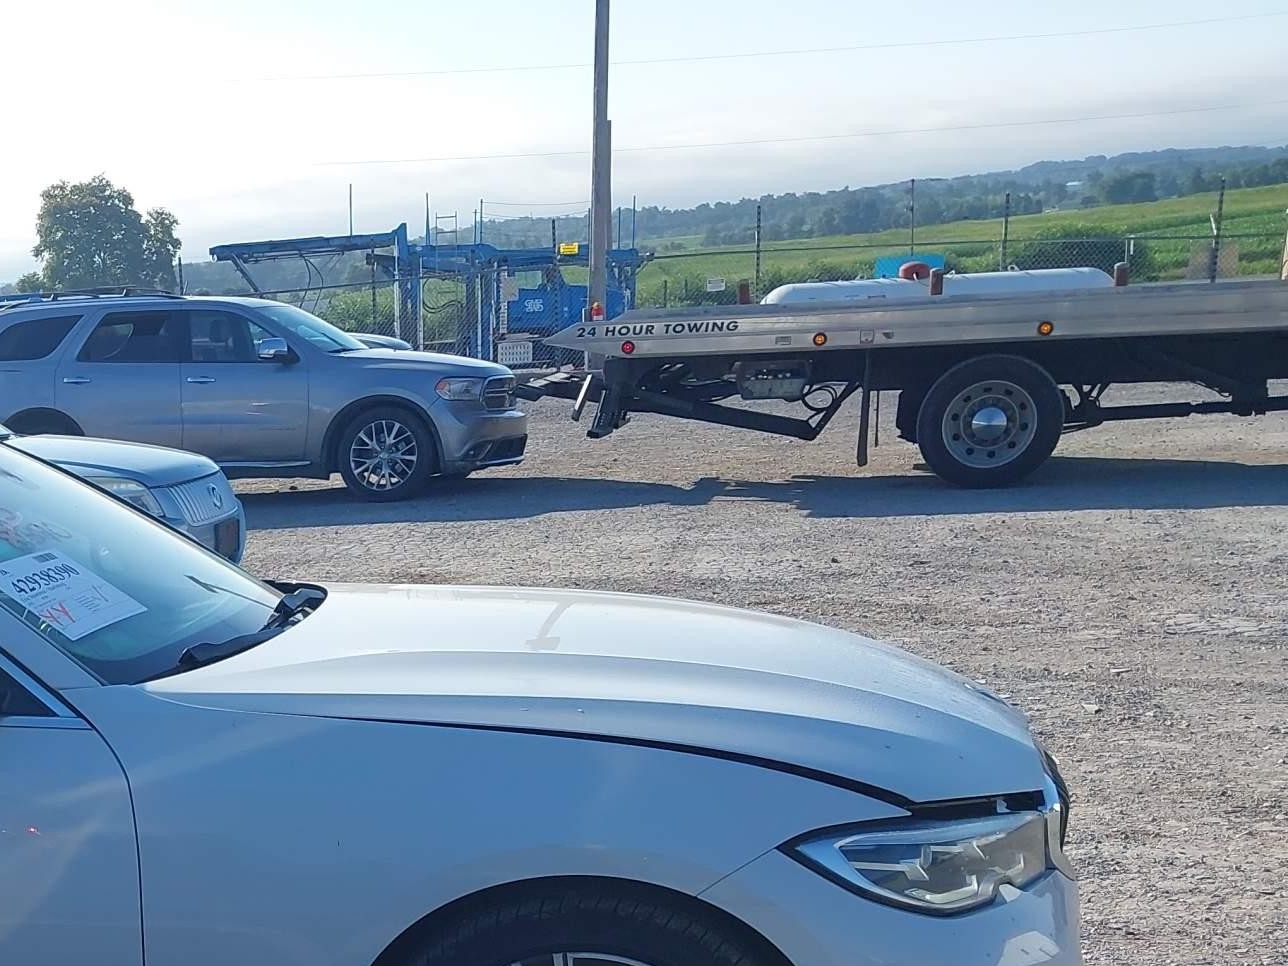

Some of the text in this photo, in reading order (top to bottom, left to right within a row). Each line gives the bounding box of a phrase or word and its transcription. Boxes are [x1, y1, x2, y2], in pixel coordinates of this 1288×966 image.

[576, 320, 740, 338] 24 HOUR TOWING
[11, 563, 81, 595] 42938390
